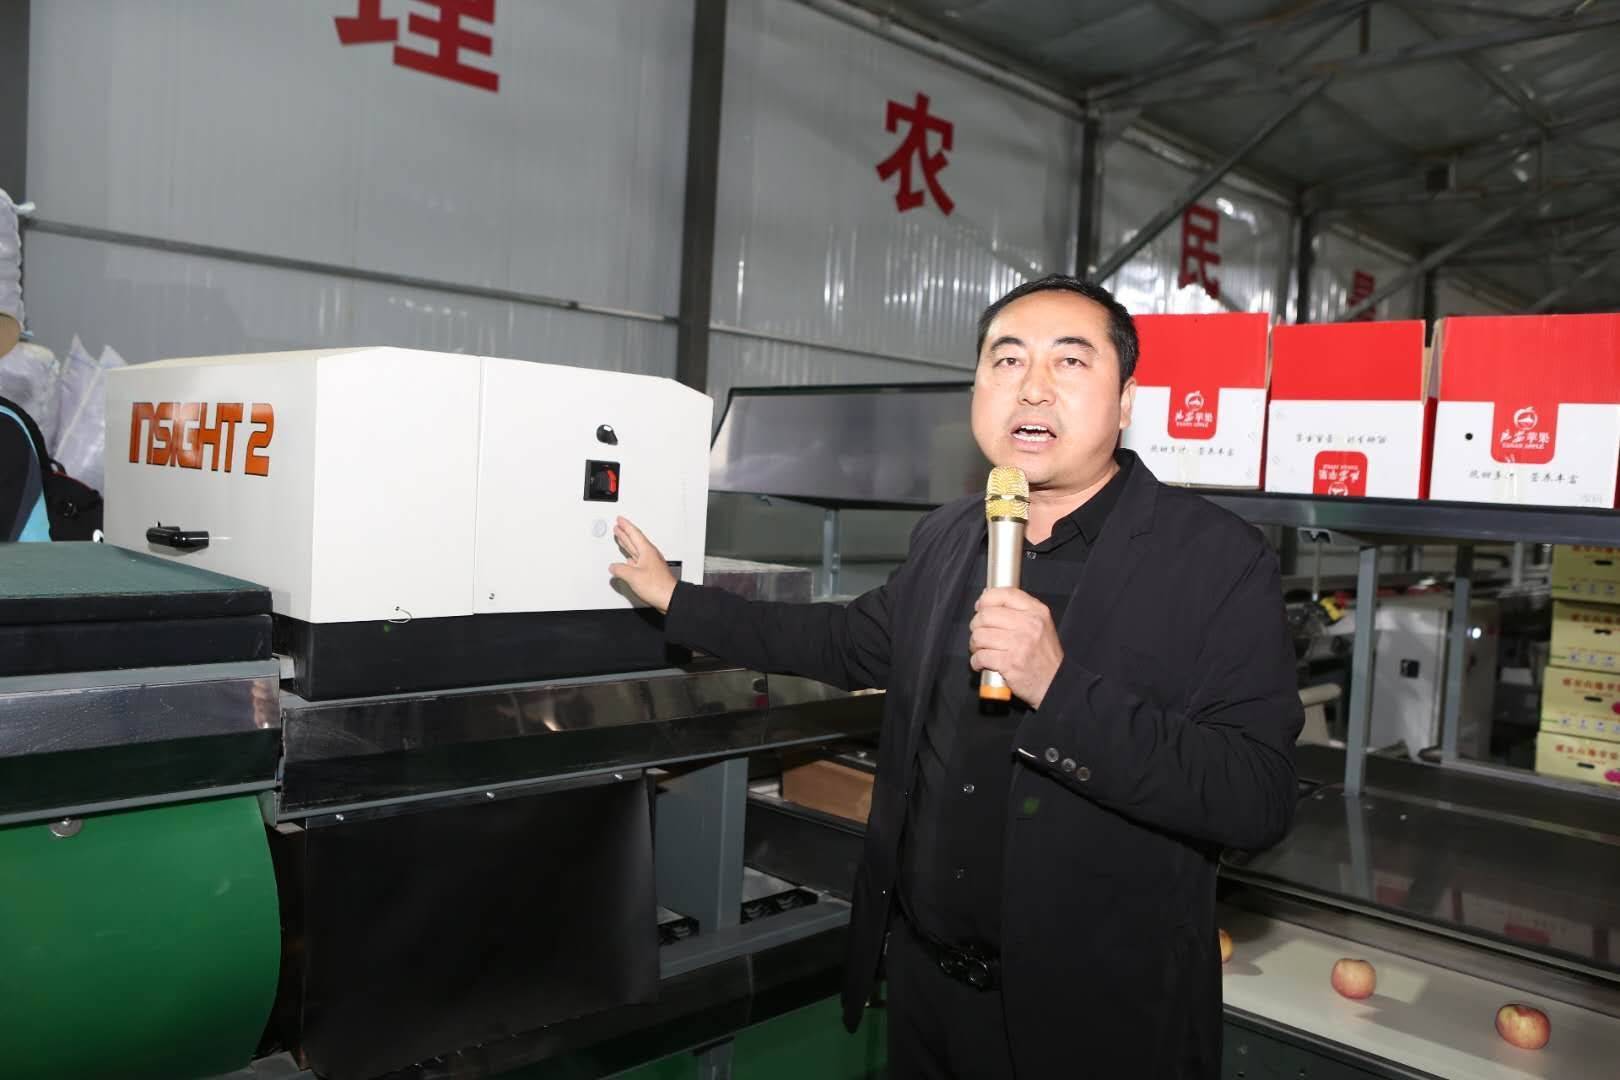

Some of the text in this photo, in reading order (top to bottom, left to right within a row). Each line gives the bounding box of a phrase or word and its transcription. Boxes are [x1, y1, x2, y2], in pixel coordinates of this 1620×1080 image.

[875, 91, 956, 217] 农
[1177, 204, 1222, 299] 民
[129, 402, 275, 477] INSIGHT 2
